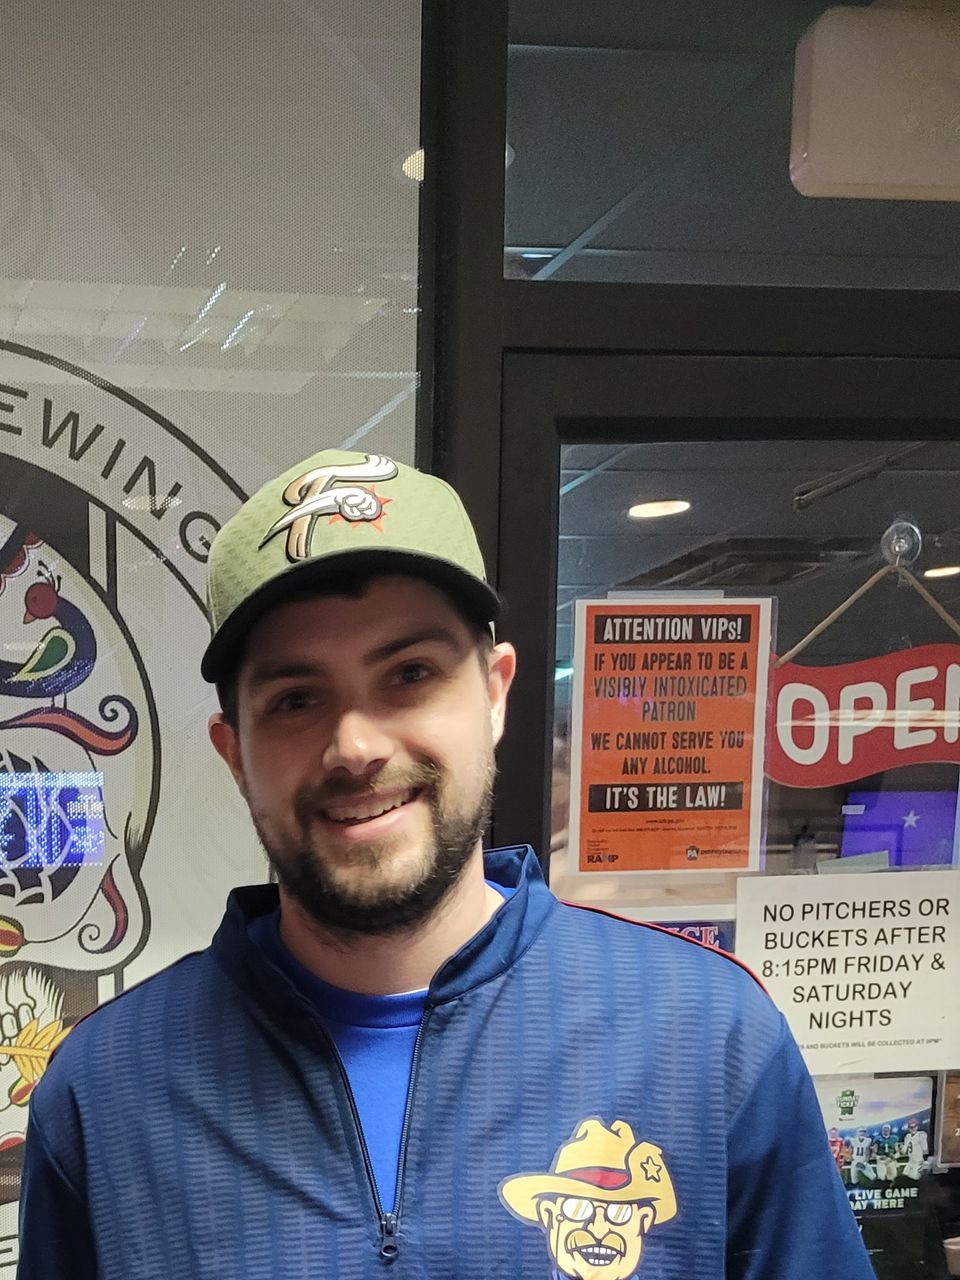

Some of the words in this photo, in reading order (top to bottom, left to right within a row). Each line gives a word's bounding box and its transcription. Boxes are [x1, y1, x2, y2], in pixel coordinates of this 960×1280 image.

[603, 618, 693, 642] ATTENTION
[701, 617, 743, 641] VIPs!
[594, 653, 605, 671] IF
[611, 653, 636, 672] YOU
[642, 652, 693, 671] APPEAR
[698, 652, 714, 671] TO
[718, 652, 736, 671] BE
[740, 652, 749, 670] A
[594, 676, 648, 698] VISIBLY
[654, 675, 748, 698] INTOXICATED
[642, 701, 696, 722] PATRON
[591, 732, 610, 751] WE
[616, 731, 668, 751] CANNOT
[672, 731, 714, 750] SERVE
[720, 730, 745, 749] YOU
[622, 757, 648, 776] ANY
[653, 756, 712, 775] ALCOHOL.
[606, 786, 640, 810] IT'S
[646, 786, 678, 809] THE
[685, 785, 727, 808] LAW!
[763, 903, 795, 923] NO
[801, 899, 912, 922] PITCHERS
[918, 898, 950, 917] OR
[764, 928, 868, 950] BUCKETS
[874, 925, 947, 946] AFTER
[762, 956, 837, 978] 8:15PM
[844, 953, 925, 974] FRIDAY
[930, 952, 946, 971] &
[792, 980, 913, 1004] SATURDAY
[809, 1008, 892, 1030] NIGHTS
[820, 1042, 849, 1050] BUCKETS
[851, 1041, 866, 1049] WILL
[868, 1040, 877, 1048] BE
[878, 1039, 915, 1047] COLLECTED
[855, 1189, 882, 1200] LIVE
[885, 1188, 918, 1198] GAME
[874, 1198, 905, 1209] HERE
